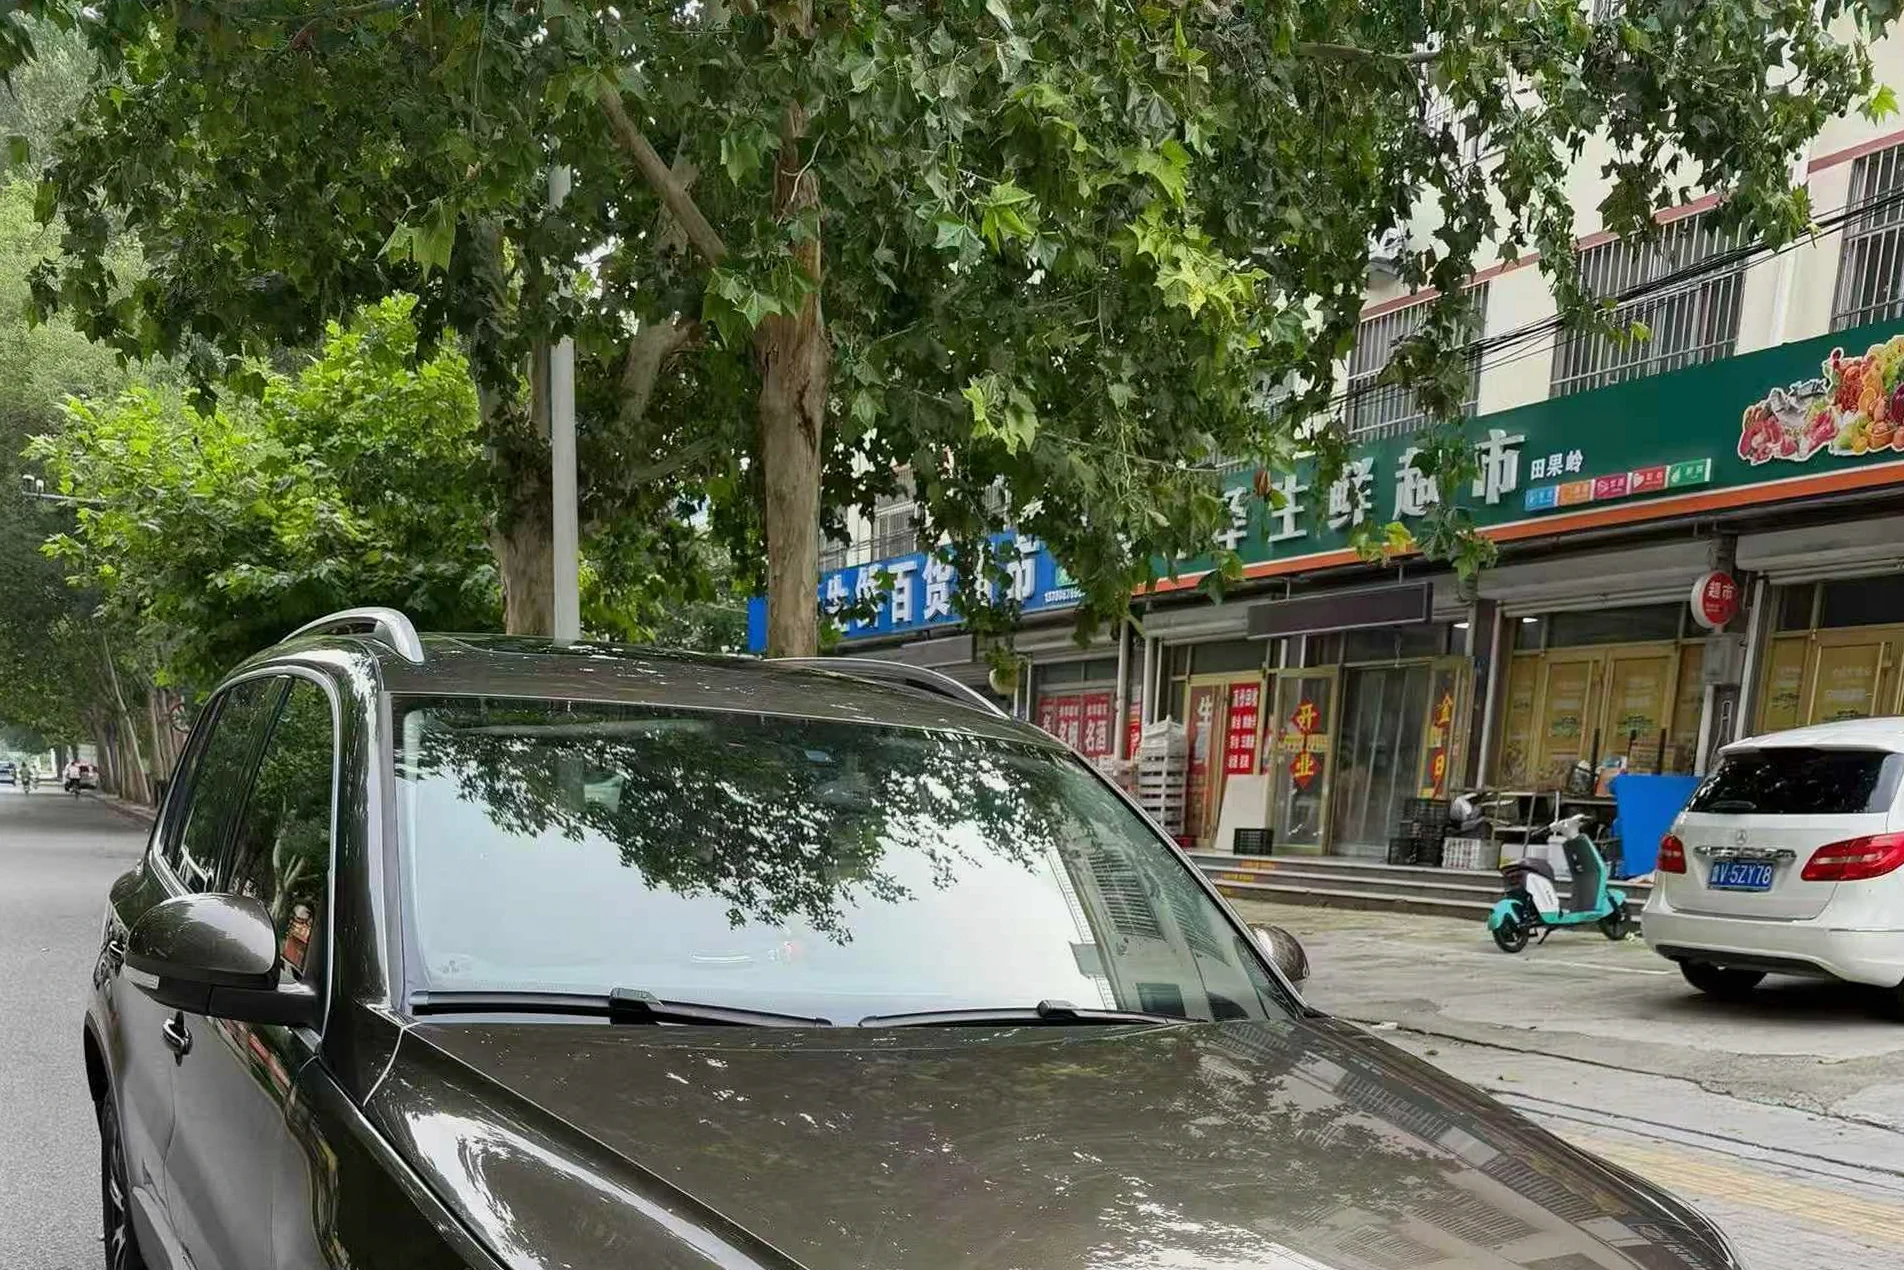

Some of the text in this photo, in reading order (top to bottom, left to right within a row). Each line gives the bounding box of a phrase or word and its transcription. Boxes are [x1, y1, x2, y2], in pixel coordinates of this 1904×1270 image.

[1530, 449, 1583, 480] 田果岭
[1708, 580, 1734, 600] 超市
